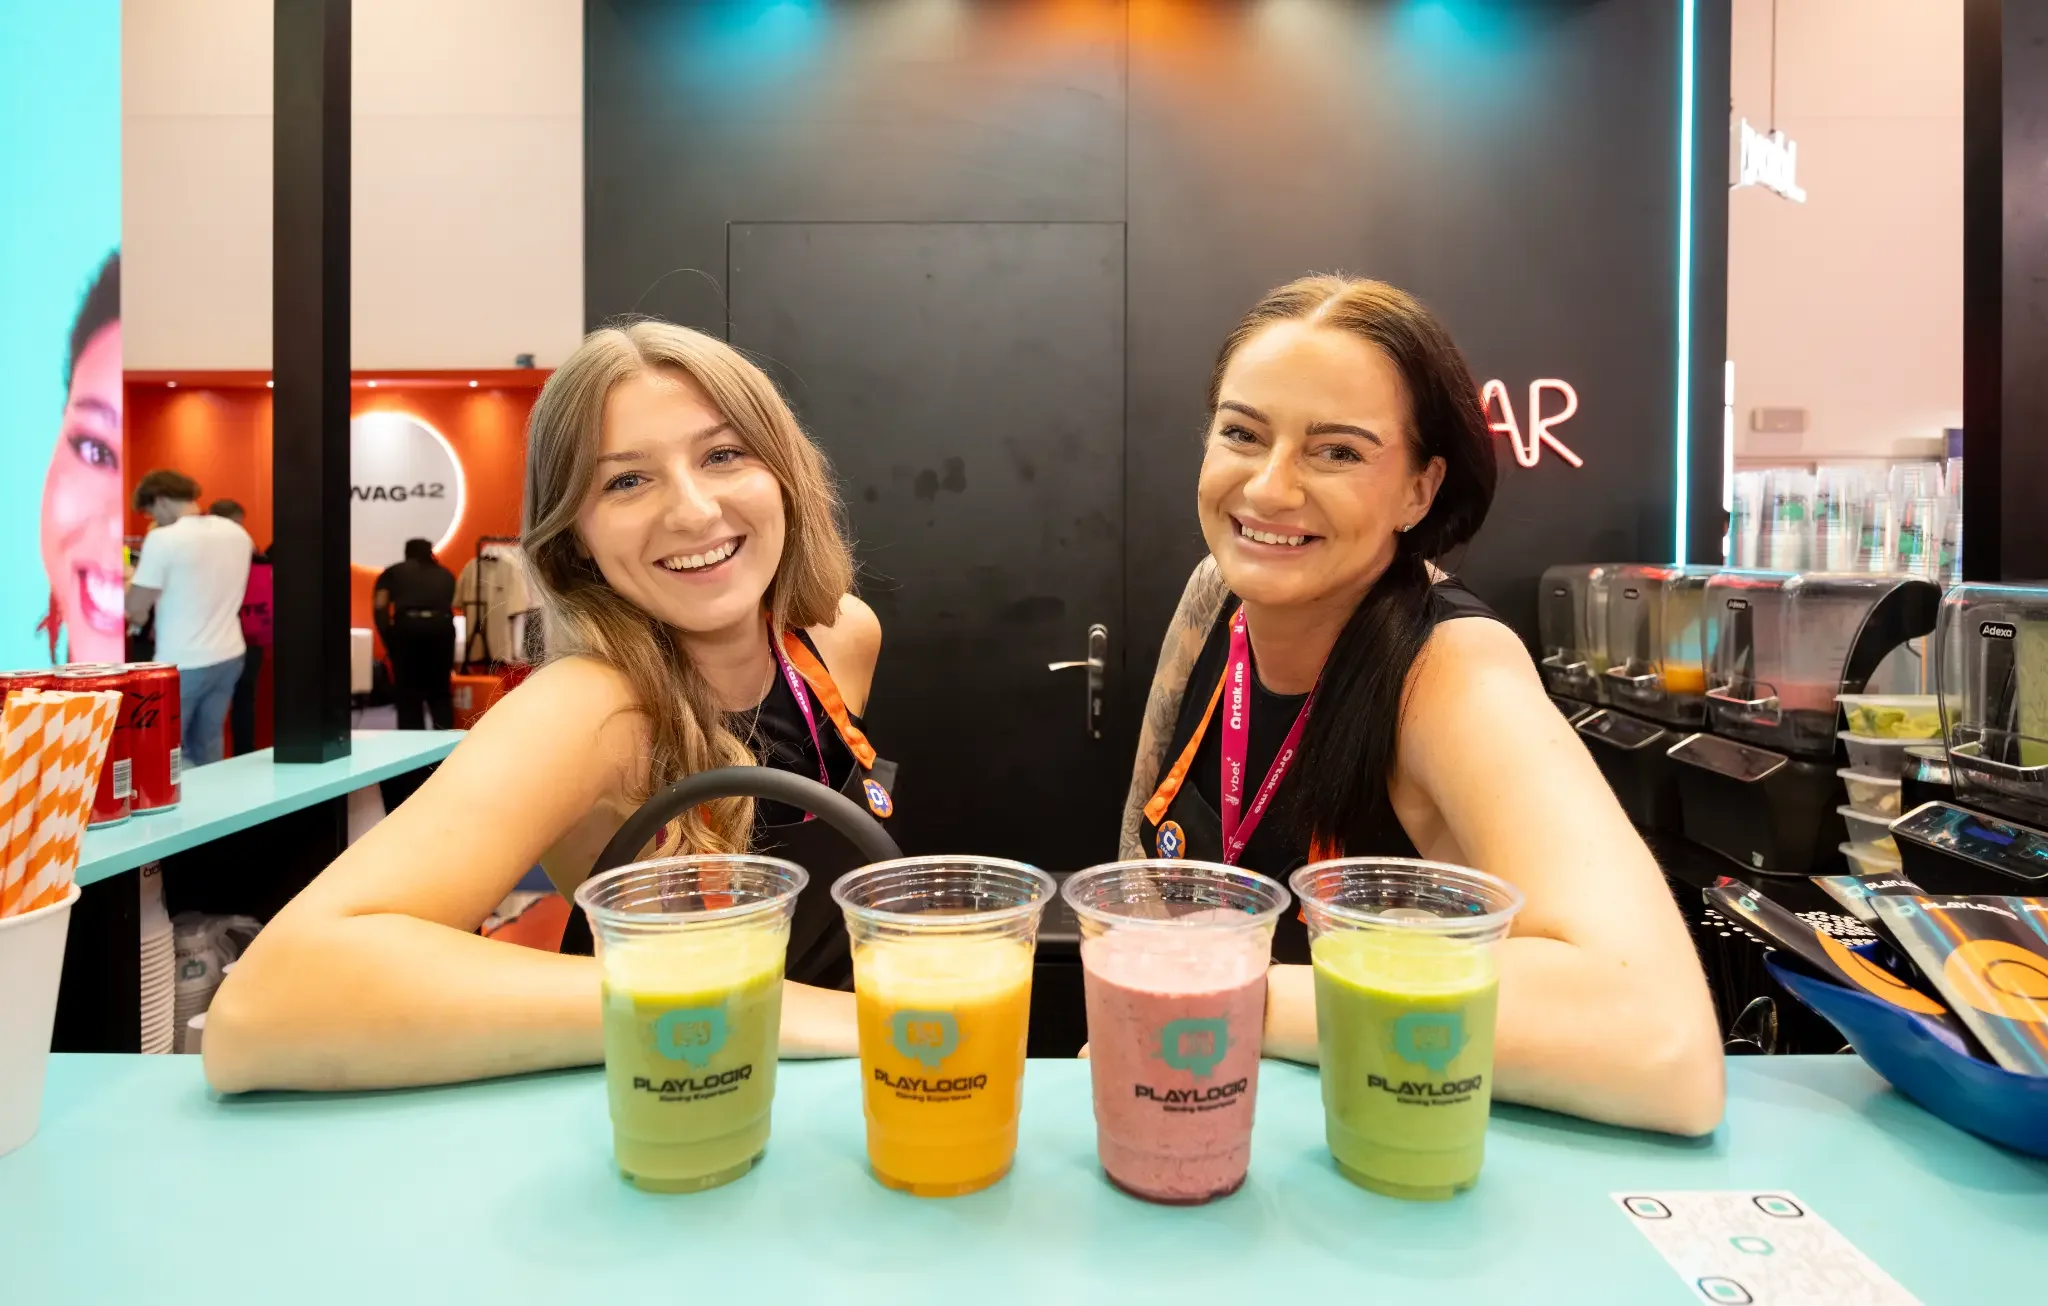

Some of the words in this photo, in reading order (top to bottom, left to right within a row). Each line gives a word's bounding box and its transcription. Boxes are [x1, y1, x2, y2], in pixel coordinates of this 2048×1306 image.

[1981, 624, 2013, 638] Adexa
[1230, 761, 1241, 792] vbet
[633, 1064, 752, 1092] PLAYLOGIQ
[874, 1068, 988, 1093] PLAYLOGIQ
[1134, 1078, 1247, 1102] PLAYLOGIQ
